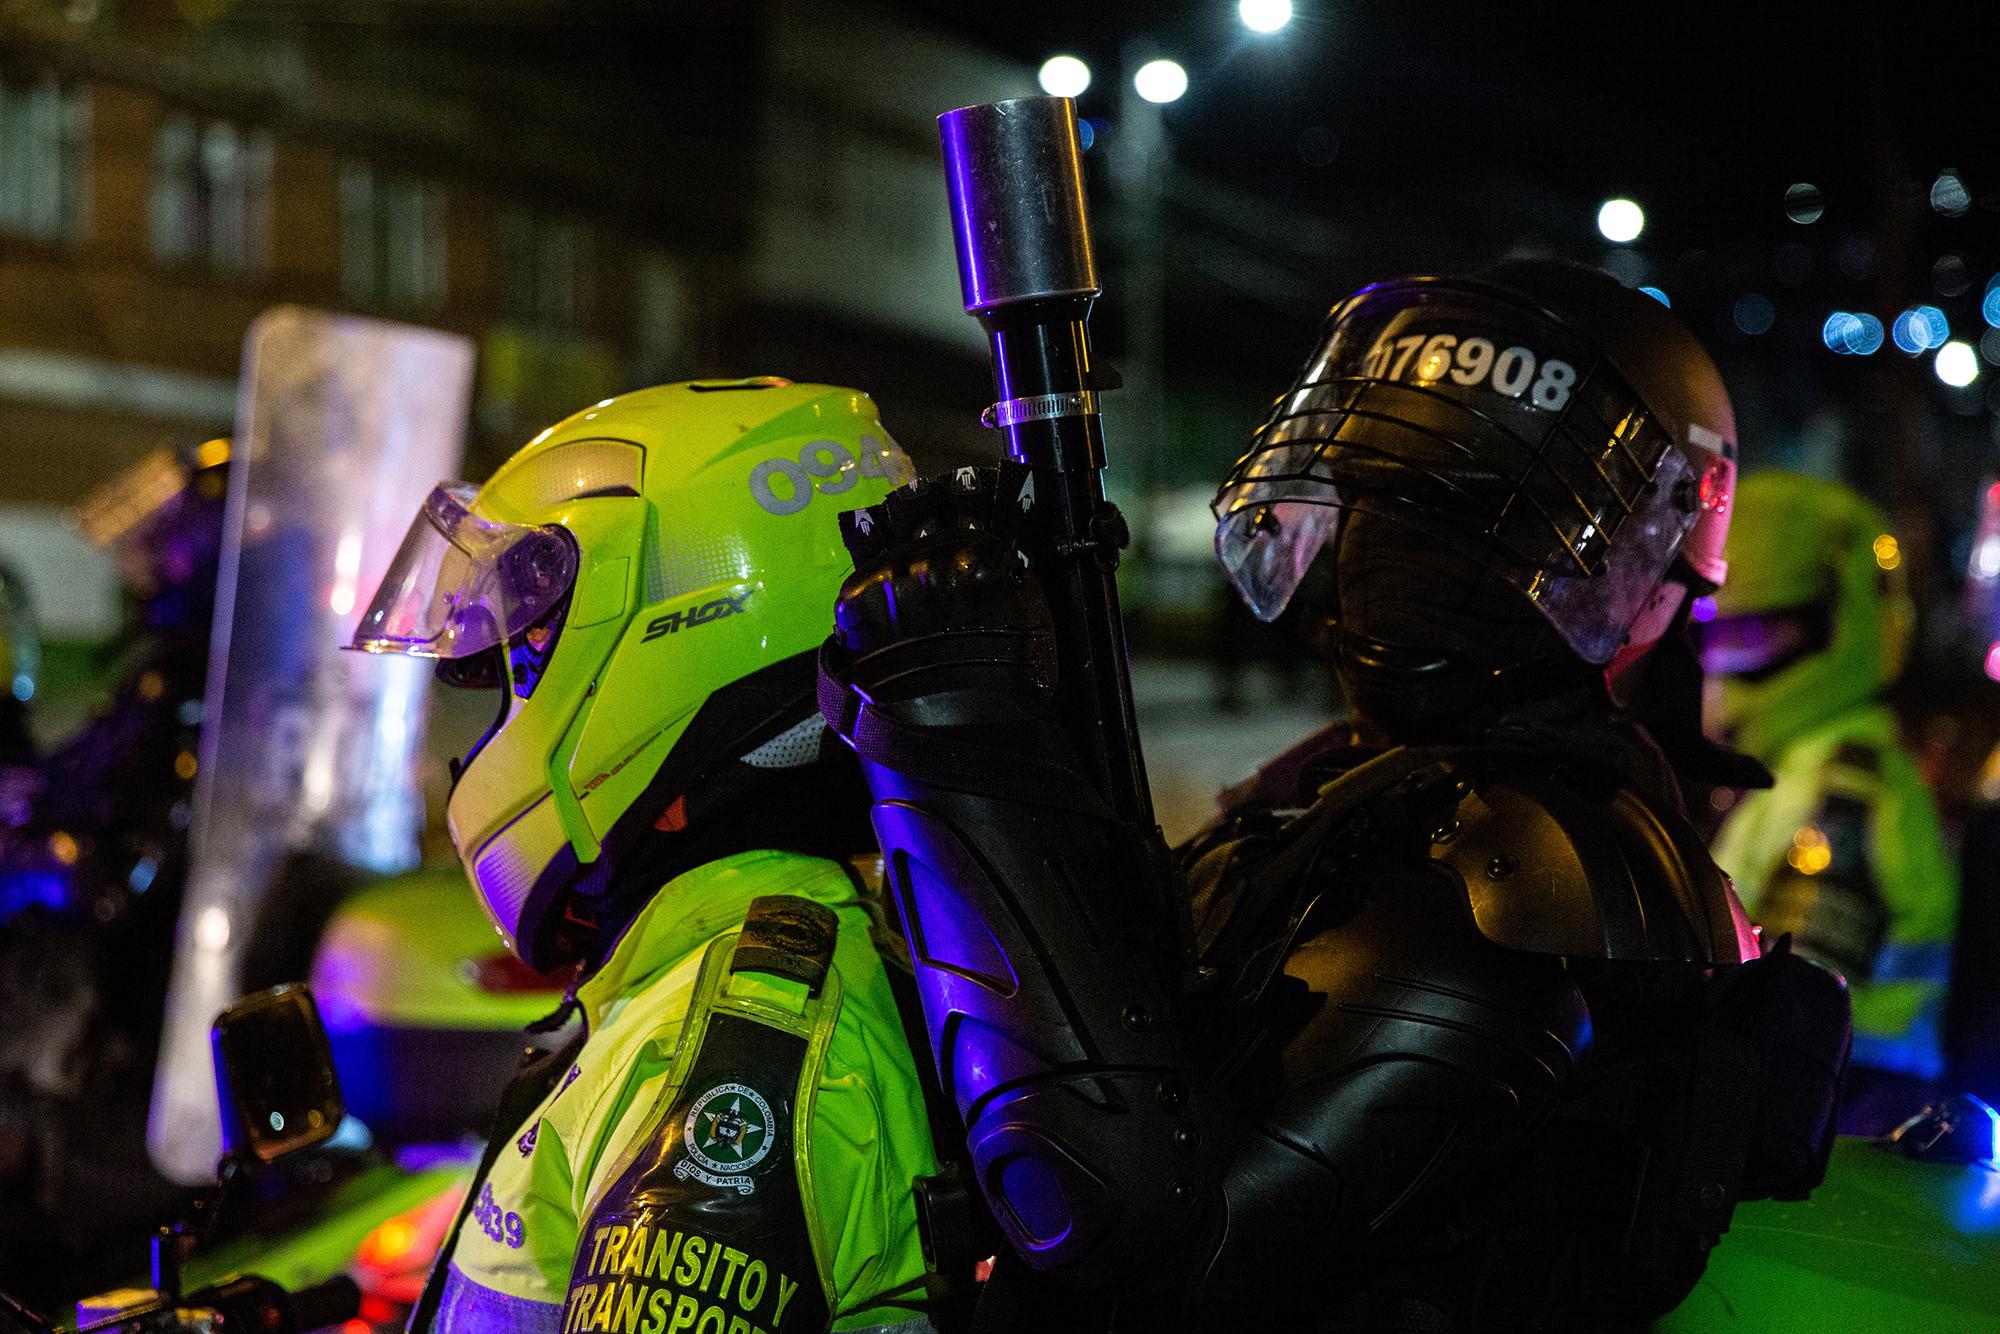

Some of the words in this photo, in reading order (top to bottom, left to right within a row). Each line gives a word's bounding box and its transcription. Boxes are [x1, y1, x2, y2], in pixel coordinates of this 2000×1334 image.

[640, 589, 755, 644] SHOX
[738, 1085, 750, 1095] DE
[755, 1096, 774, 1137] COLOMBIA
[680, 1160, 702, 1178] DIOS
[716, 1177, 751, 1185] PATRIA
[720, 1158, 757, 1171] NACIONAL
[564, 1282, 768, 1334] TRANSPO
[772, 1273, 799, 1328] Y
